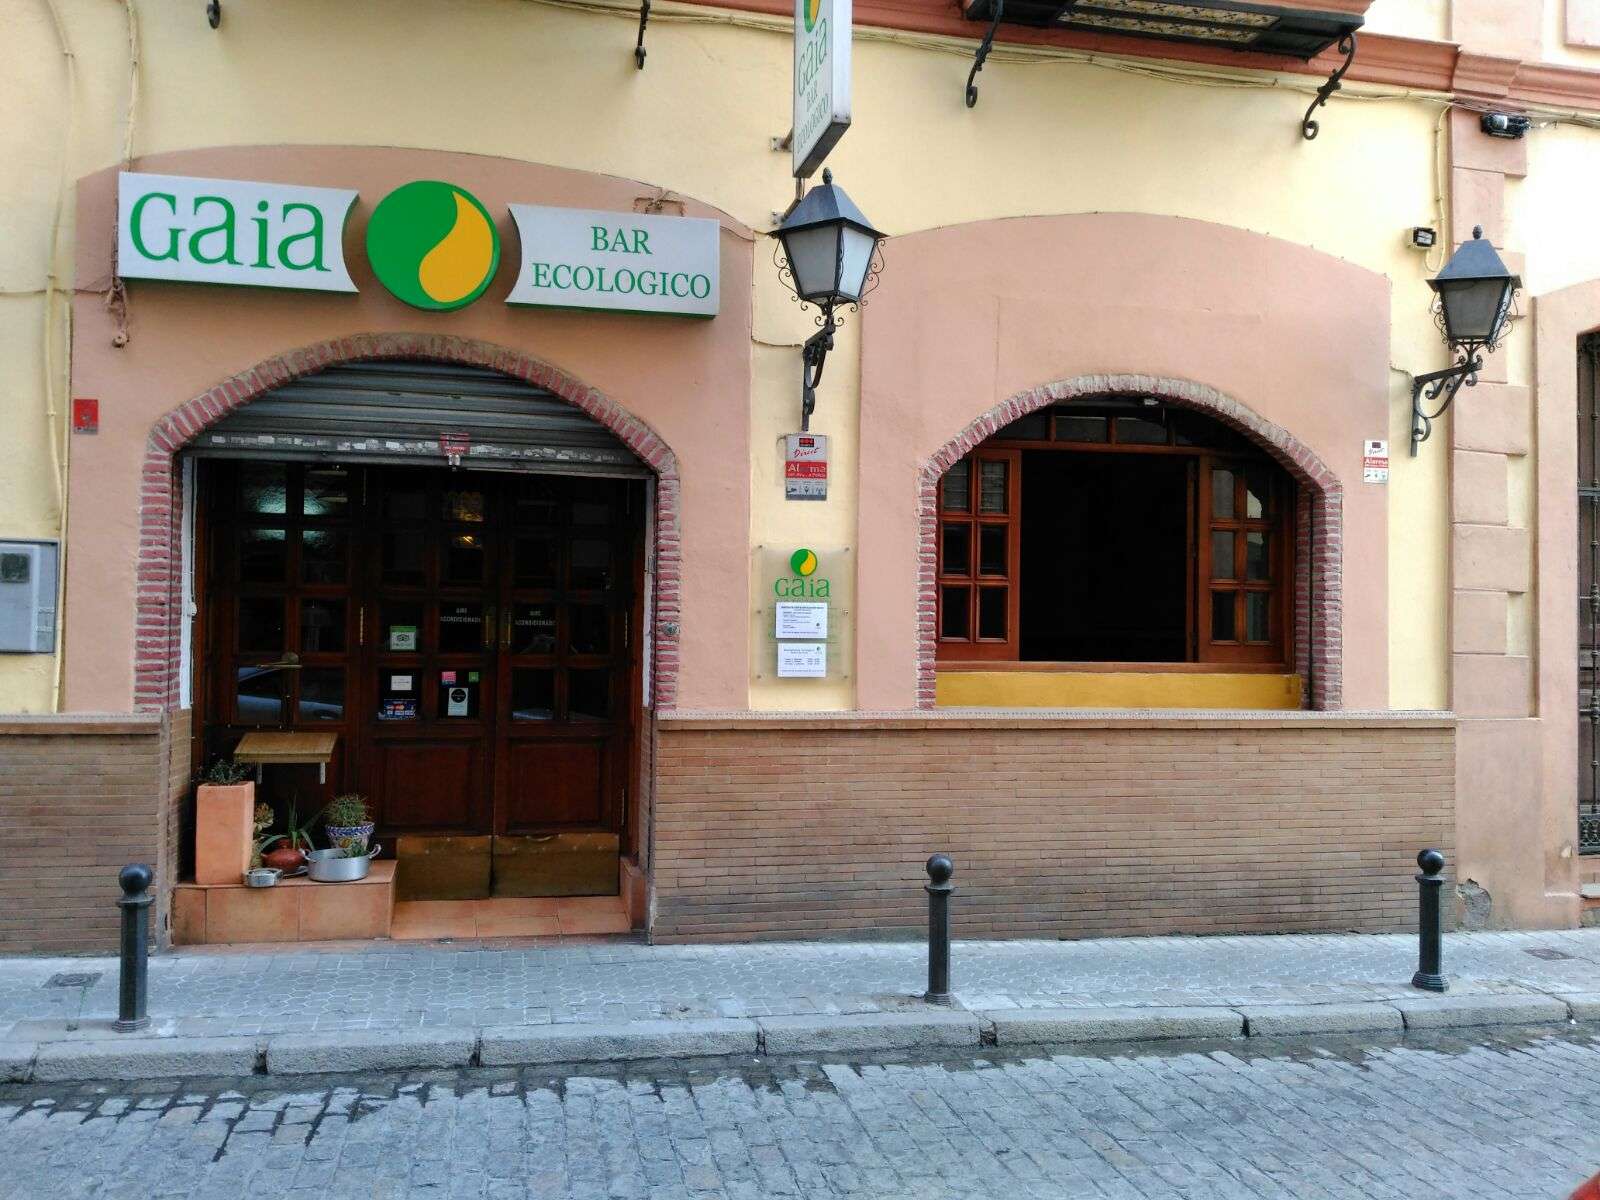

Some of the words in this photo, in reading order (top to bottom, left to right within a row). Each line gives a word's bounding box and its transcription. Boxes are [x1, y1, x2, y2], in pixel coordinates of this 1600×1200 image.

[130, 191, 332, 273] Gaia
[591, 225, 652, 256] BAR
[531, 262, 712, 300] ECOLOGICO
[774, 577, 831, 598] Gaia
